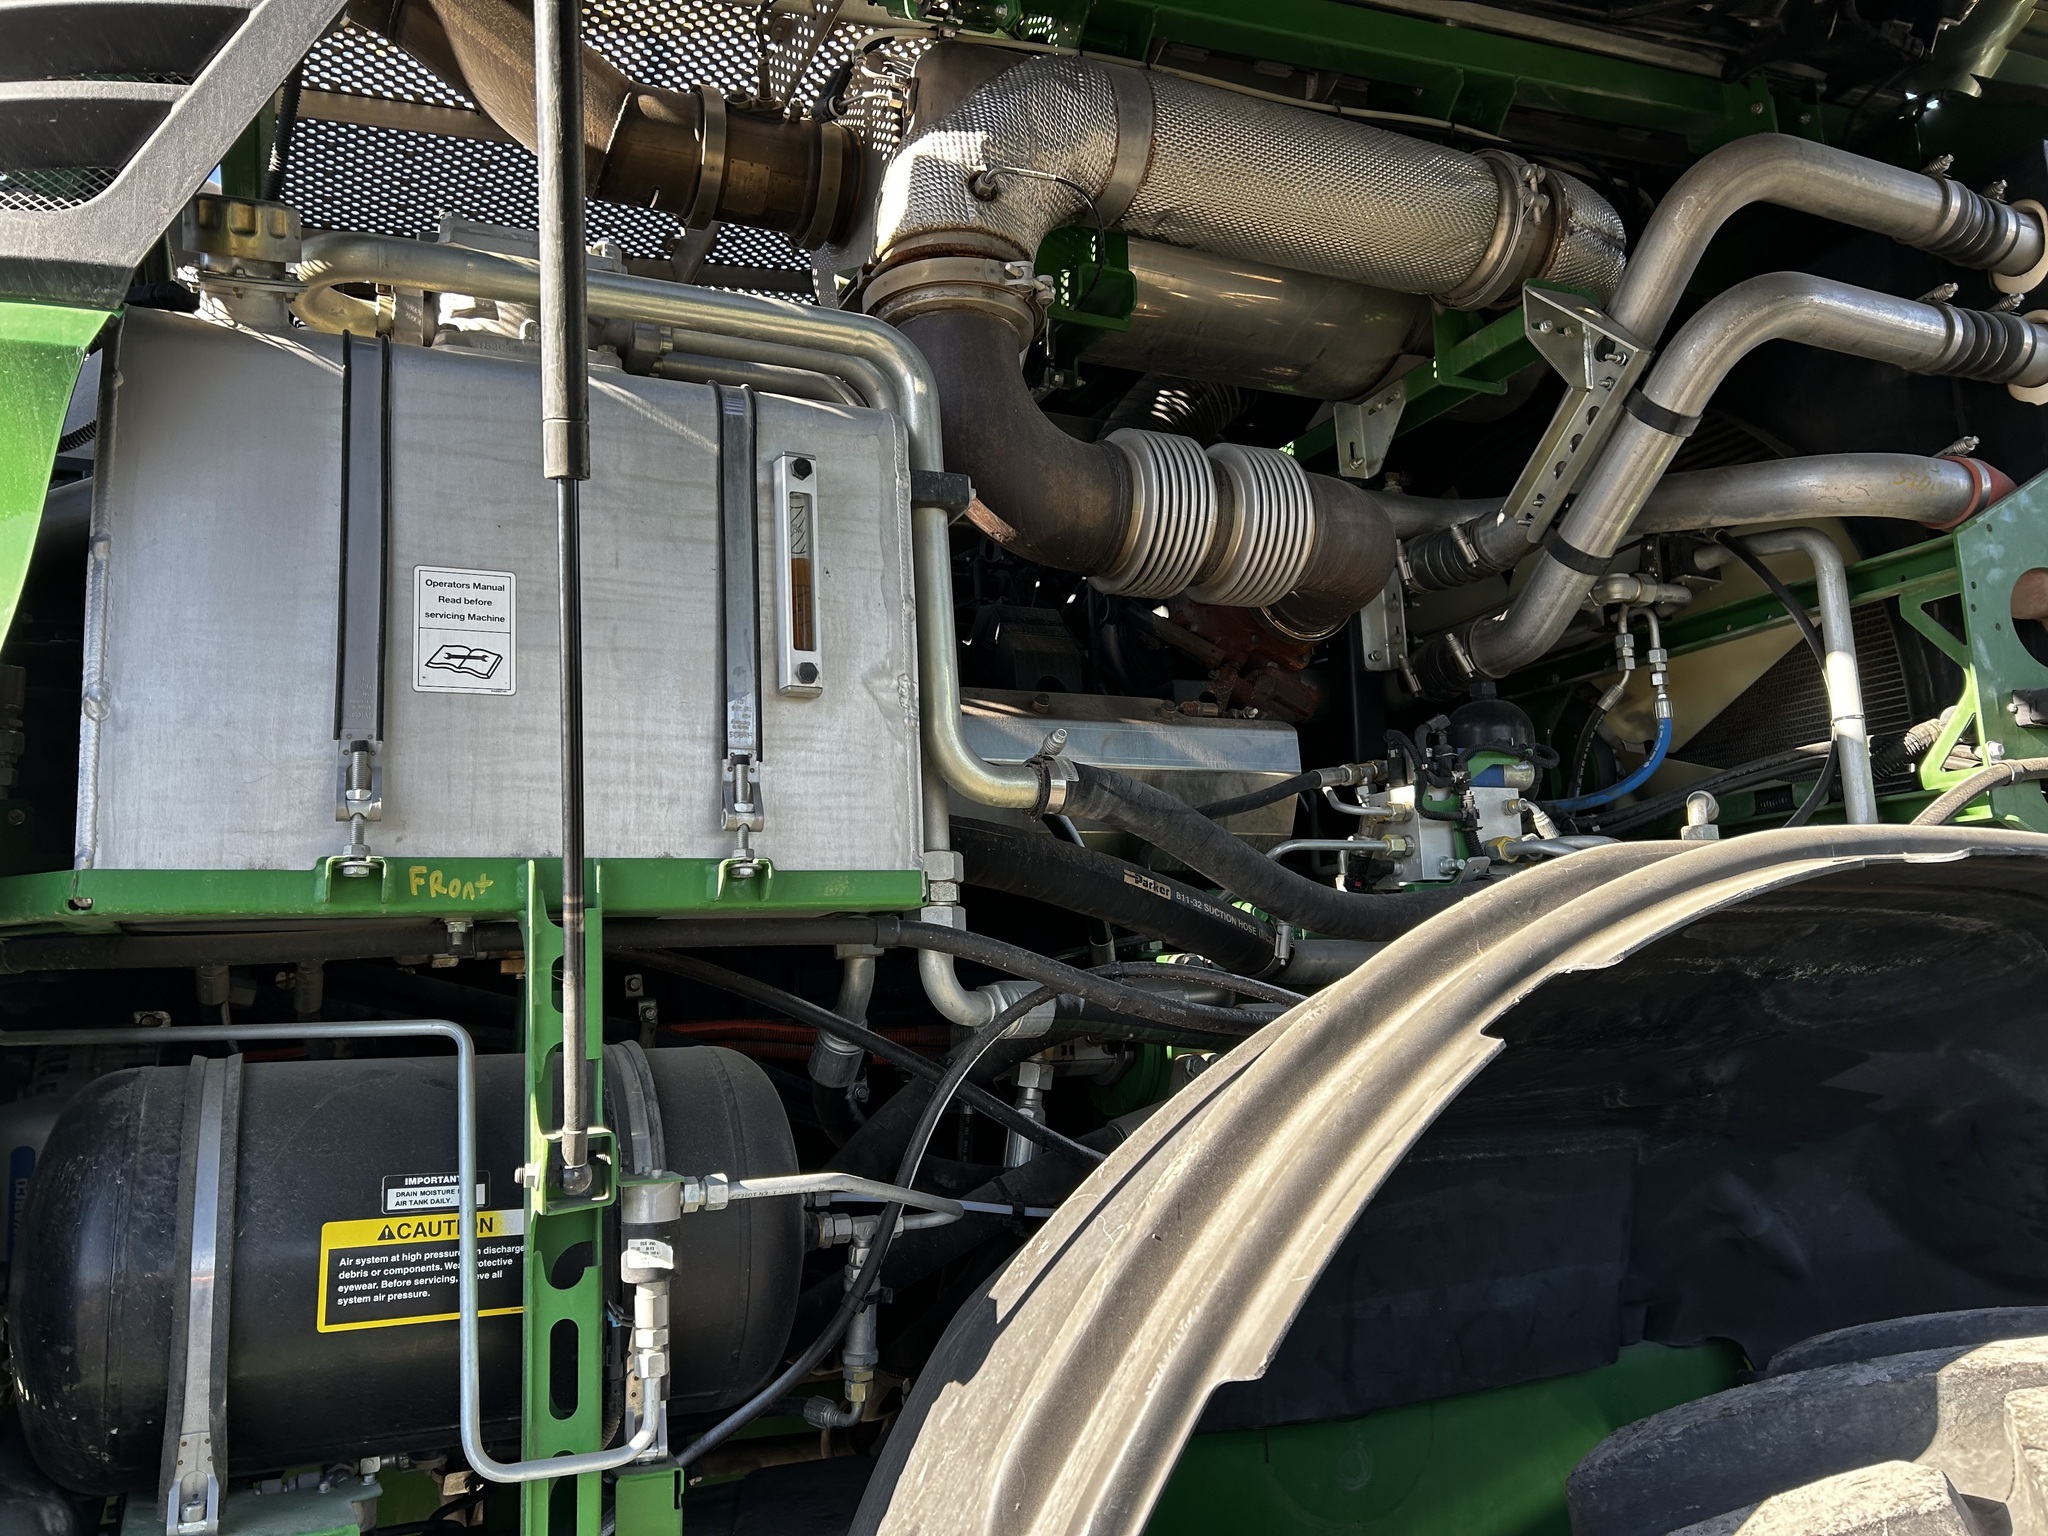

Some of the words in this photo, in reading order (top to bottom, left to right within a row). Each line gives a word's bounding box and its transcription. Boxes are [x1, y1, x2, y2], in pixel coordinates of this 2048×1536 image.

[425, 578, 470, 590] Operators
[472, 582, 505, 592] Manual
[438, 595, 462, 604] Read
[464, 597, 492, 606] before
[425, 611, 465, 622] servicing
[468, 613, 505, 623] Machine
[1132, 873, 1171, 897] Parker
[1176, 891, 1202, 910] 811-32
[1204, 903, 1237, 925] SUCTION
[1238, 920, 1257, 935] HOSE
[395, 1190, 418, 1198] DRAIN
[420, 1188, 456, 1197] MOISTURE
[394, 1199, 408, 1207] AIR
[409, 1198, 428, 1206] TANK
[430, 1197, 453, 1205] DAILY.
[396, 1217, 494, 1239] CAUTIN
[338, 1257, 354, 1267] Air
[355, 1254, 389, 1266] system
[390, 1254, 400, 1262] at
[401, 1252, 422, 1264] high
[483, 1244, 524, 1256] discharge
[338, 1269, 369, 1280] debris
[370, 1268, 381, 1276] or
[384, 1264, 443, 1278] components.
[338, 1281, 379, 1294] eyewear.
[381, 1278, 412, 1290] Before
[414, 1274, 458, 1287] servicing,
[492, 1270, 503, 1279] all
[337, 1294, 371, 1306] system
[373, 1292, 386, 1302] air
[388, 1288, 430, 1302] pressure.
